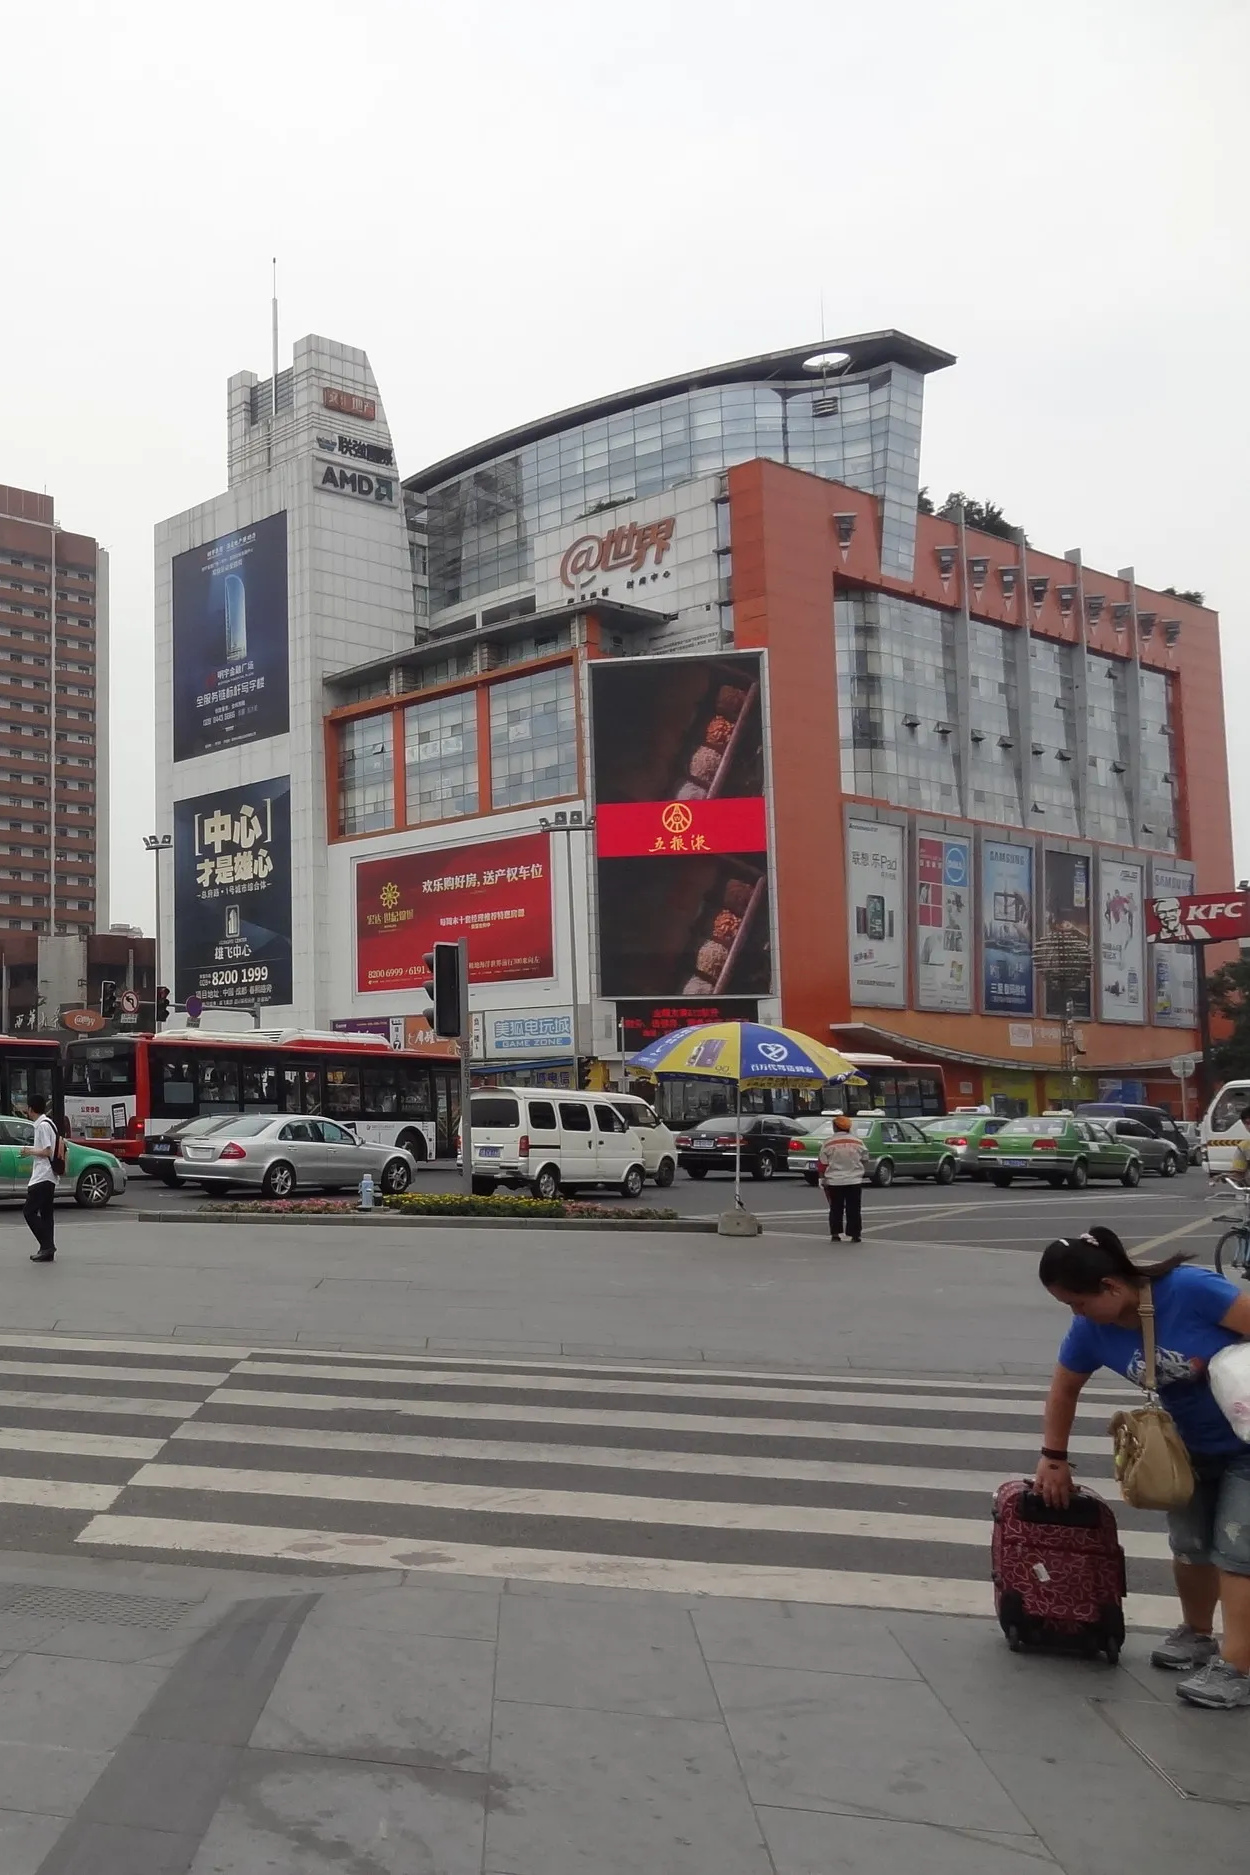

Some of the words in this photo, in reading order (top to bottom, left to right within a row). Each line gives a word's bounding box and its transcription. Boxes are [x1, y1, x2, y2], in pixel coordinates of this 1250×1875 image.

[322, 466, 373, 496] AMD
[559, 517, 676, 589] @世界
[203, 804, 263, 854] 中心
[648, 833, 711, 852] 五粮液
[989, 850, 1025, 866] SAMSUNG
[1186, 902, 1245, 921] KFC
[214, 944, 252, 960] 雄飞中心
[212, 969, 238, 986] 8200
[241, 966, 268, 983] 1999
[368, 969, 385, 979] 8200
[385, 967, 403, 977] 6999
[494, 1015, 571, 1038] 美狐电玩城
[502, 1038, 531, 1047] GAME
[533, 1037, 563, 1046] ZONE
